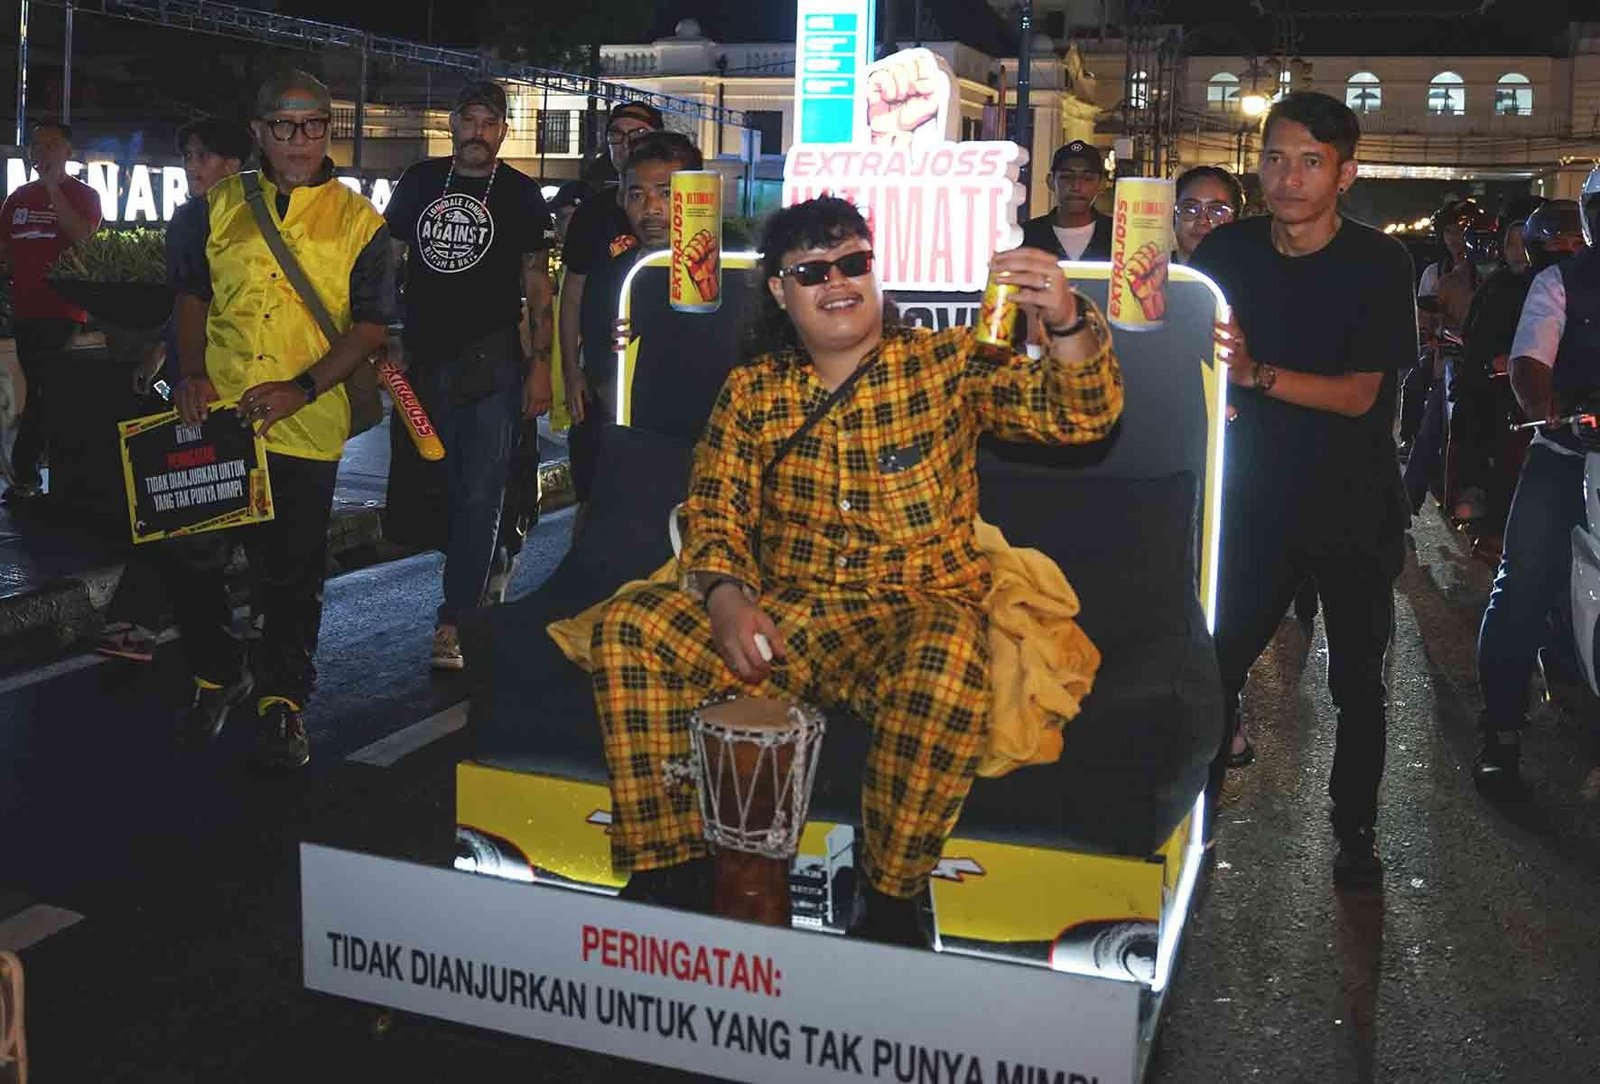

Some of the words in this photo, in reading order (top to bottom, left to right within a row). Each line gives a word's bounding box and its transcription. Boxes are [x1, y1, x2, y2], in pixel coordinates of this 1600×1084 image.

[791, 149, 1003, 177] EXTRAJOSS
[422, 220, 488, 244] AGAINST
[671, 190, 683, 301] EXTRAJOSS
[1110, 198, 1128, 319] EXTRAJOSS
[145, 472, 169, 494] TIDAK
[169, 464, 219, 489] DIANJURKAN
[217, 459, 246, 479] UNTUK
[153, 491, 175, 512] YANG
[175, 488, 191, 509] TAK
[190, 484, 217, 506] PUNYA
[216, 480, 243, 500] MIMPI
[581, 923, 782, 997] PERINGATAN:
[326, 931, 403, 981] TIDAK
[411, 948, 586, 1020] DIANJURKAN
[596, 985, 697, 1042] UNTUK
[705, 1005, 790, 1061] YANG
[800, 1025, 863, 1075] TAK
[873, 1038, 981, 1084] PUNYA
